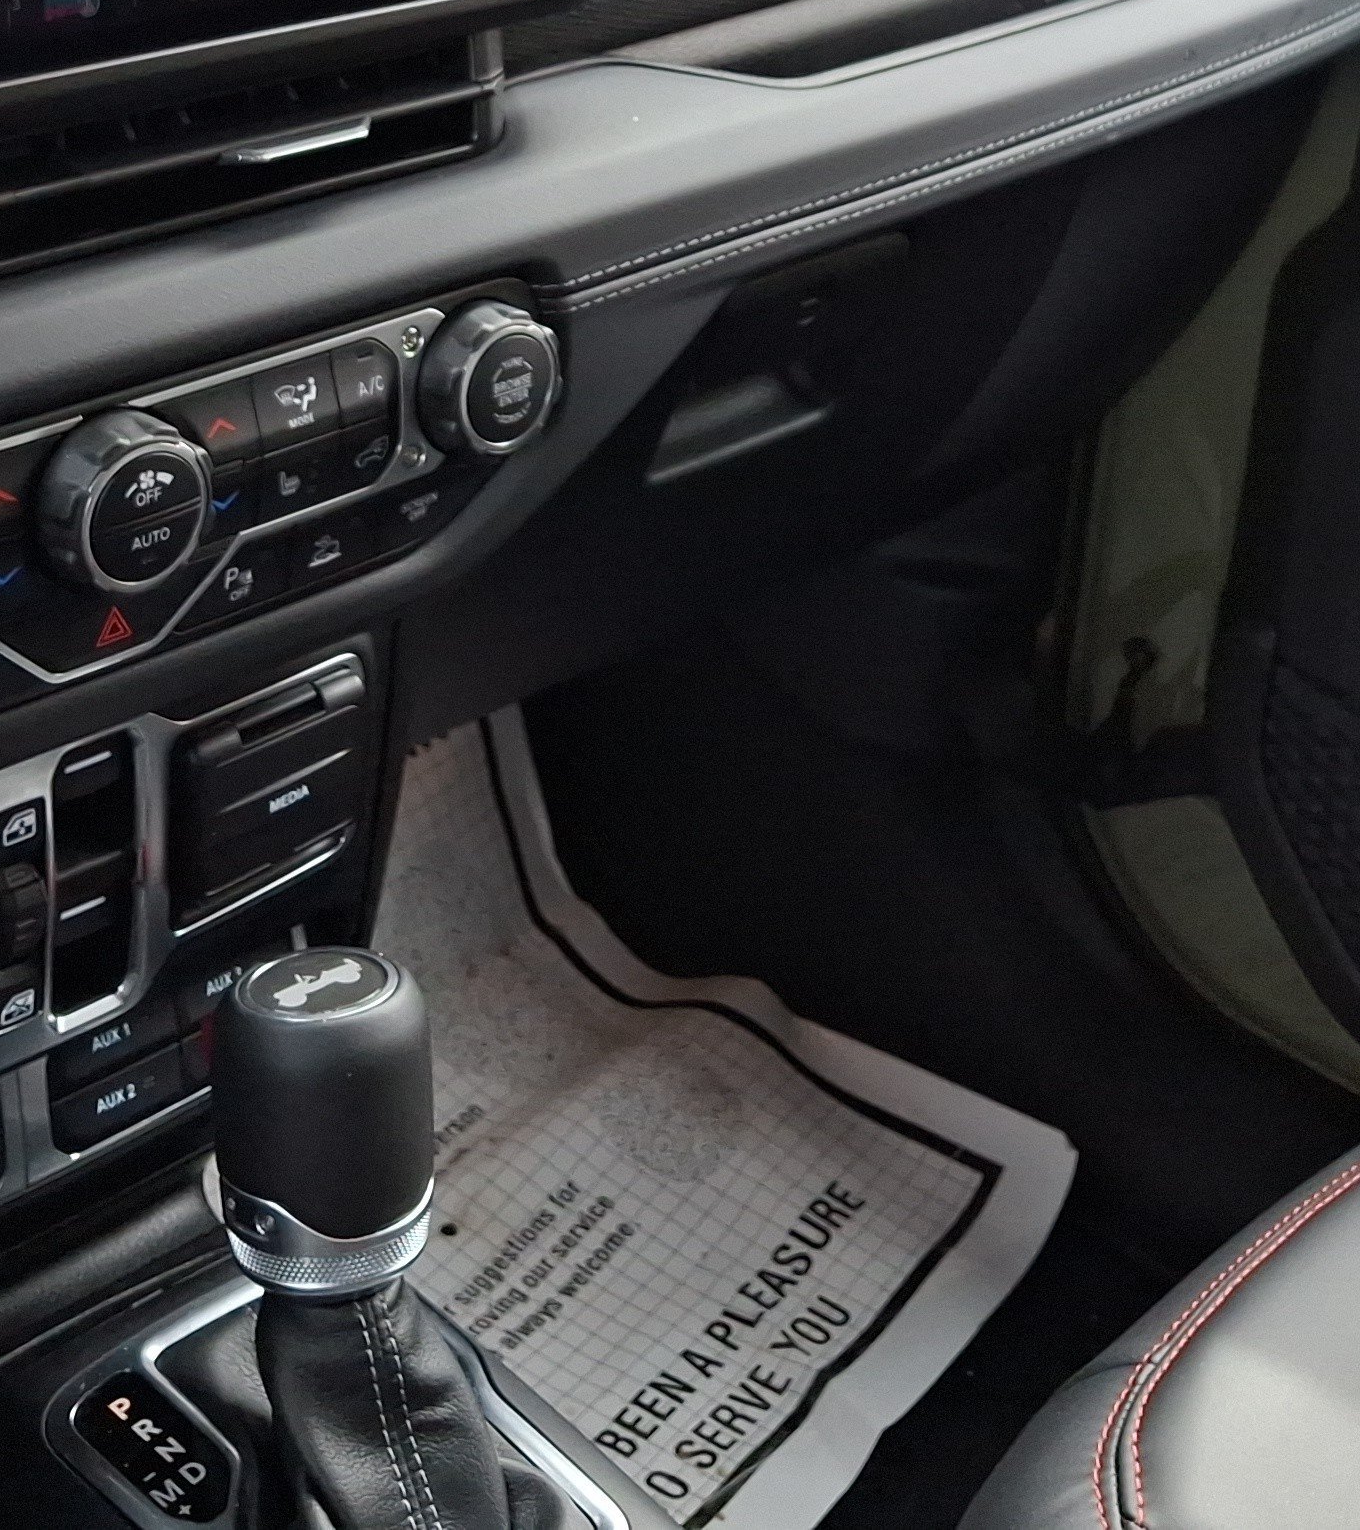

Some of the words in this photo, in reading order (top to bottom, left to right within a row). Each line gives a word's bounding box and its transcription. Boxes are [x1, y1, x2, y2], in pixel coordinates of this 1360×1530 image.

[358, 374, 384, 398] A/C
[136, 487, 162, 507] OFF
[131, 527, 170, 551] AUTO
[269, 784, 310, 814] MEDIA
[206, 974, 234, 997] AUX
[91, 1028, 122, 1053] AUX
[96, 1091, 126, 1115] AUX
[455, 1210, 556, 1306] suggestions
[548, 1180, 581, 1209] for
[521, 1259, 554, 1289] our
[552, 1195, 616, 1261] service
[499, 1297, 563, 1350] always
[594, 1374, 697, 1459] BEEN
[680, 1346, 725, 1380] A
[708, 1179, 866, 1357] PLEASURE
[673, 1364, 791, 1470] SERVE
[771, 1295, 853, 1364] YOU
[106, 1396, 132, 1422] P
[130, 1418, 163, 1443] R
[153, 1436, 188, 1464] N
[177, 1461, 208, 1486] D
[148, 1478, 186, 1508] M
